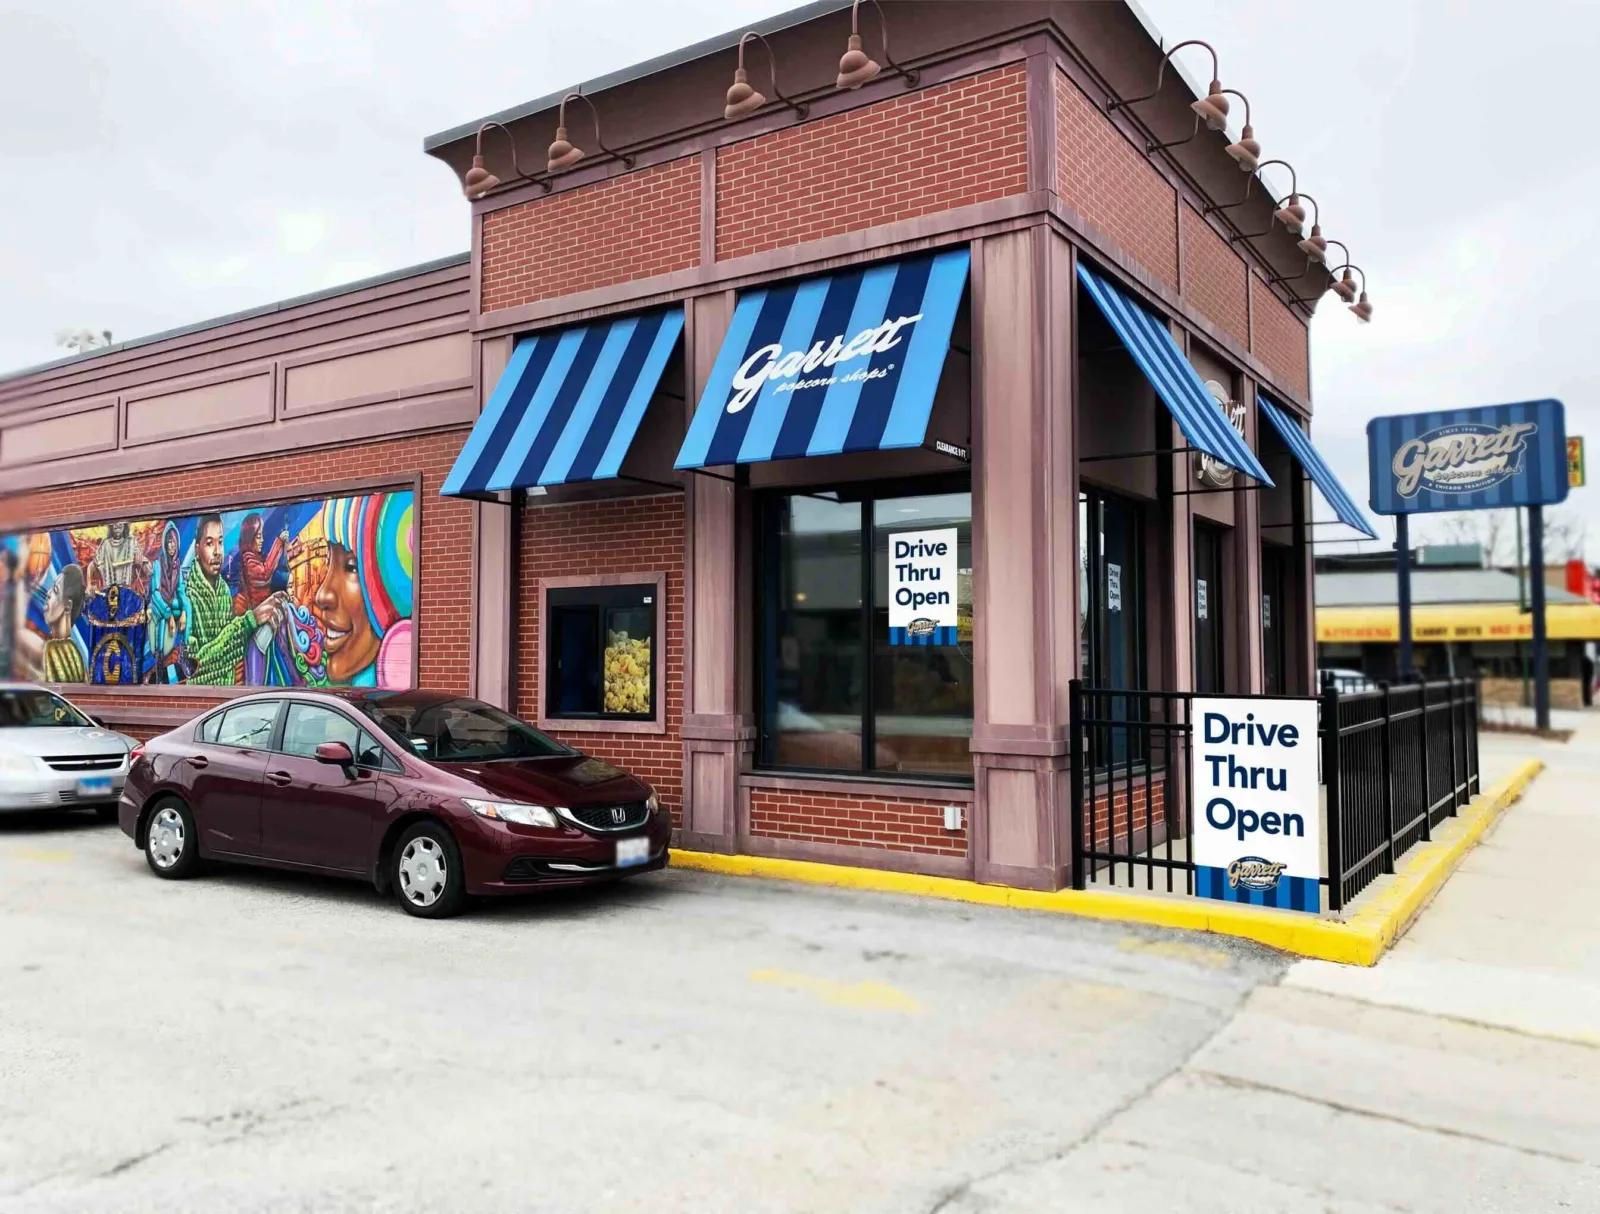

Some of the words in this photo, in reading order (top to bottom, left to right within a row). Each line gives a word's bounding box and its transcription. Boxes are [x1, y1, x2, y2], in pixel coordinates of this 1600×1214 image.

[727, 313, 924, 414] Garrett
[773, 376, 838, 396] popcorn
[936, 440, 958, 456] CLEARANCE
[1393, 423, 1534, 494] Garrett
[1464, 478, 1496, 490] TRADITION
[895, 539, 948, 559] Drive
[895, 563, 941, 582] Thru
[895, 588, 950, 610] Open
[1204, 712, 1299, 748] Drive
[1204, 754, 1287, 791] Thru
[1205, 797, 1304, 841] Open
[1227, 860, 1286, 889] Garrett
